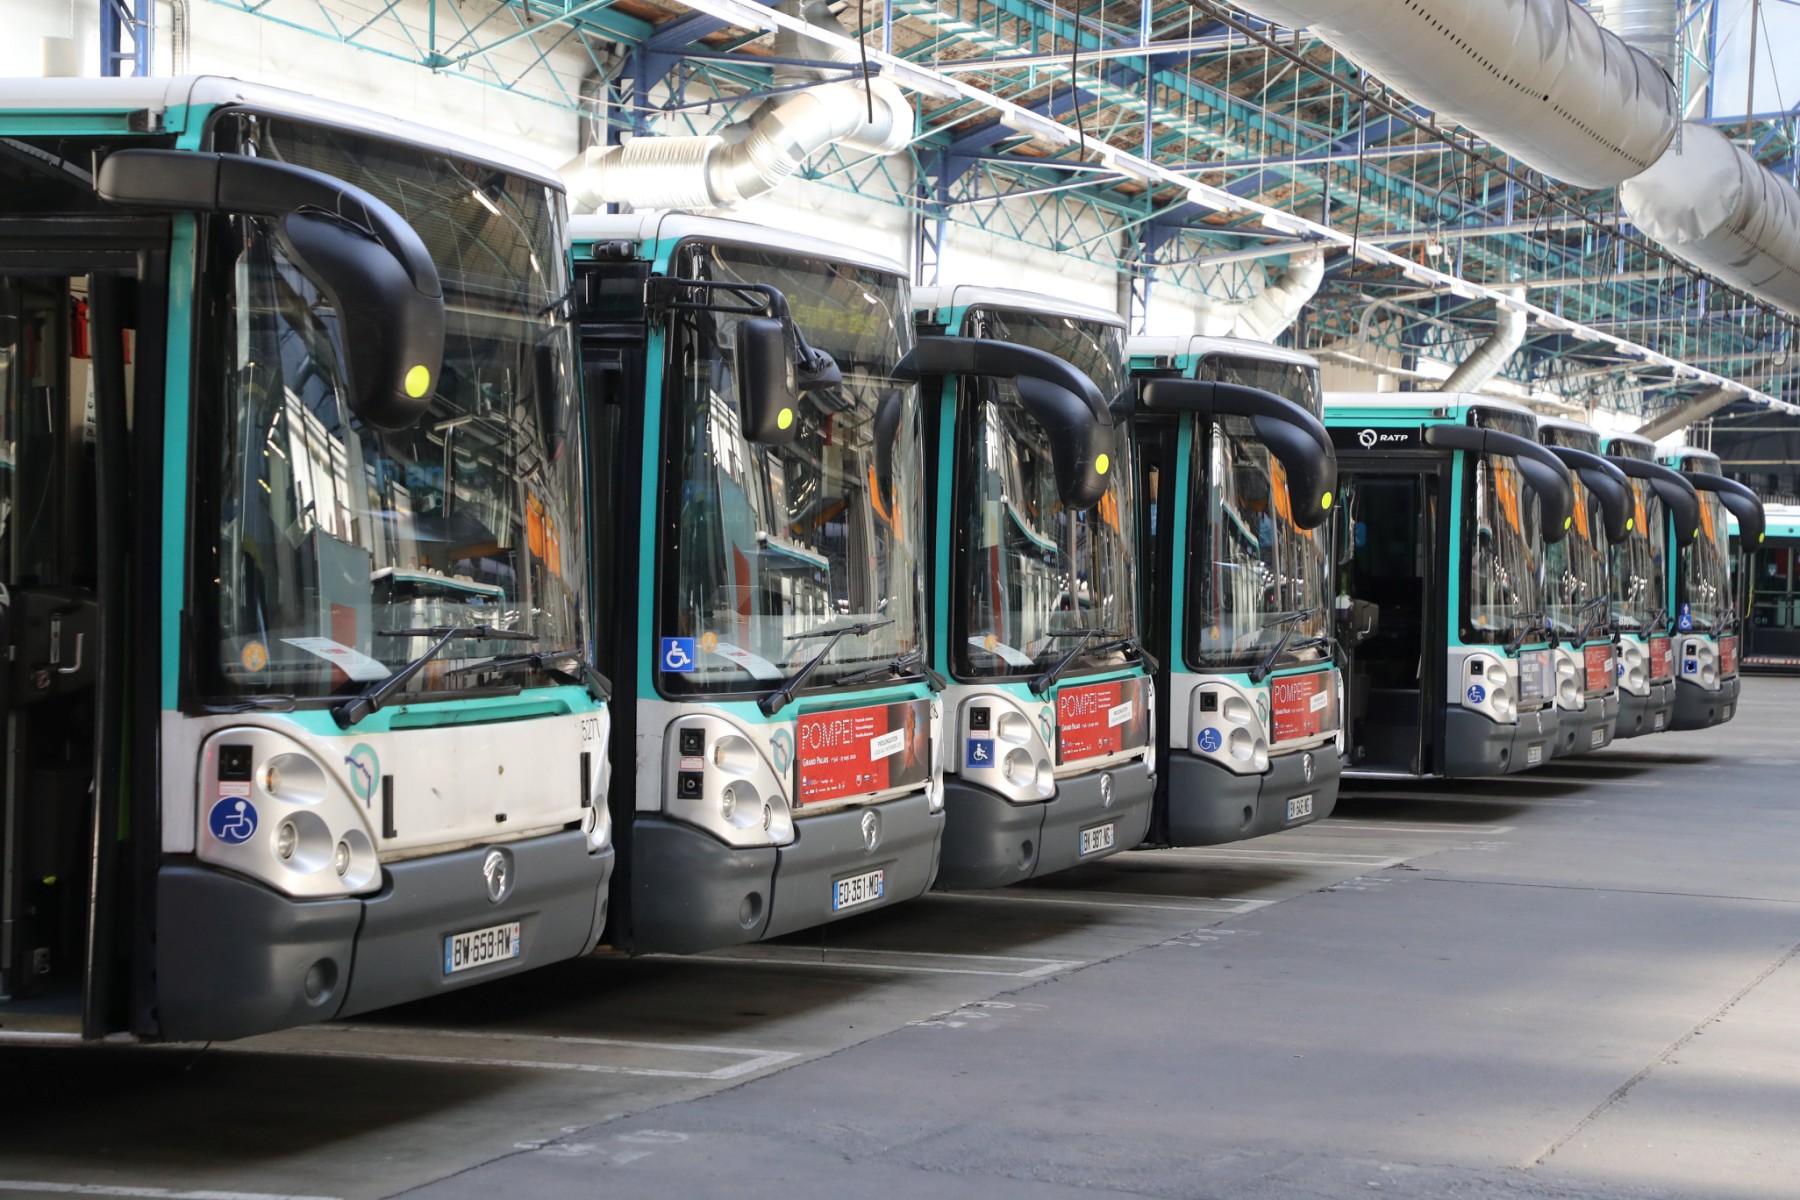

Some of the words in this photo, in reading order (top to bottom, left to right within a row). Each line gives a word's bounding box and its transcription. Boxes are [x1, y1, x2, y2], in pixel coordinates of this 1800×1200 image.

[1380, 434, 1409, 442] RATP
[1061, 692, 1097, 718] POMPEI
[802, 718, 853, 750] POMPEI
